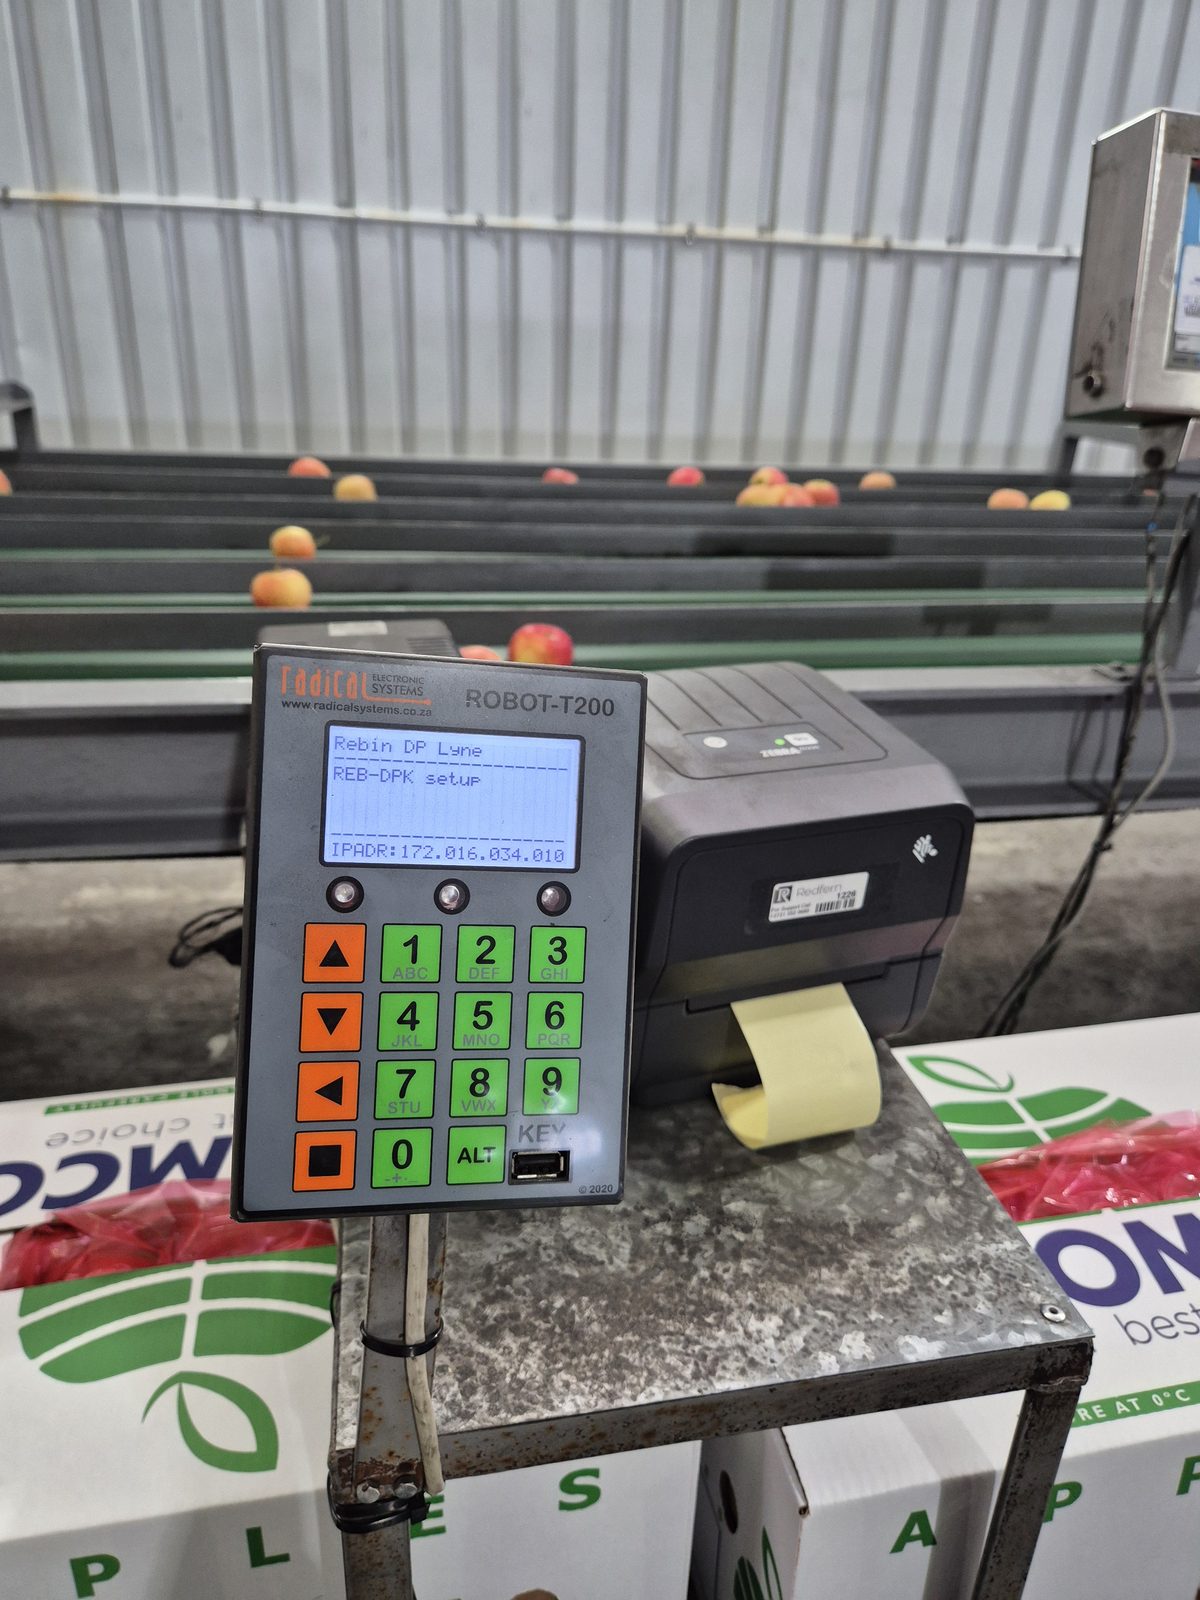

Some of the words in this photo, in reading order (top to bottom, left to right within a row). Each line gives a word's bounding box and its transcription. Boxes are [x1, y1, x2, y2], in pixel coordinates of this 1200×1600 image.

[281, 664, 370, 701] radical
[371, 673, 425, 685] ELECTRONIC
[371, 683, 424, 697] SYSTEMS
[281, 700, 433, 717] www.radicalsystems.co.za
[465, 689, 615, 717] ROBOT-T200
[334, 735, 393, 752] Rebin
[403, 739, 427, 754] DP
[438, 741, 483, 758] Lyne
[333, 766, 415, 785] REB-DPK
[425, 771, 482, 787] setup
[331, 841, 565, 863] IPADR:172.016.034.010
[403, 934, 419, 965] 1
[475, 935, 497, 965] 2
[547, 936, 568, 966] 3
[393, 967, 428, 980] ABC
[468, 967, 500, 980] DEF
[540, 967, 569, 980] GHI
[396, 1001, 420, 1031] 4
[472, 1000, 494, 1030] 5
[544, 1000, 565, 1030] 6
[392, 1034, 422, 1047] JKL
[462, 1034, 500, 1046] MNO
[537, 1033, 570, 1046] PQR
[395, 1068, 417, 1099] 7
[469, 1067, 490, 1098] 8
[542, 1066, 563, 1097] 9
[388, 1101, 421, 1114] STU
[461, 1099, 496, 1113] VWX
[391, 1138, 413, 1170] 0
[457, 1147, 497, 1165] ALT
[589, 1184, 614, 1194] 2020
[1115, 1397, 1141, 1416] AT
